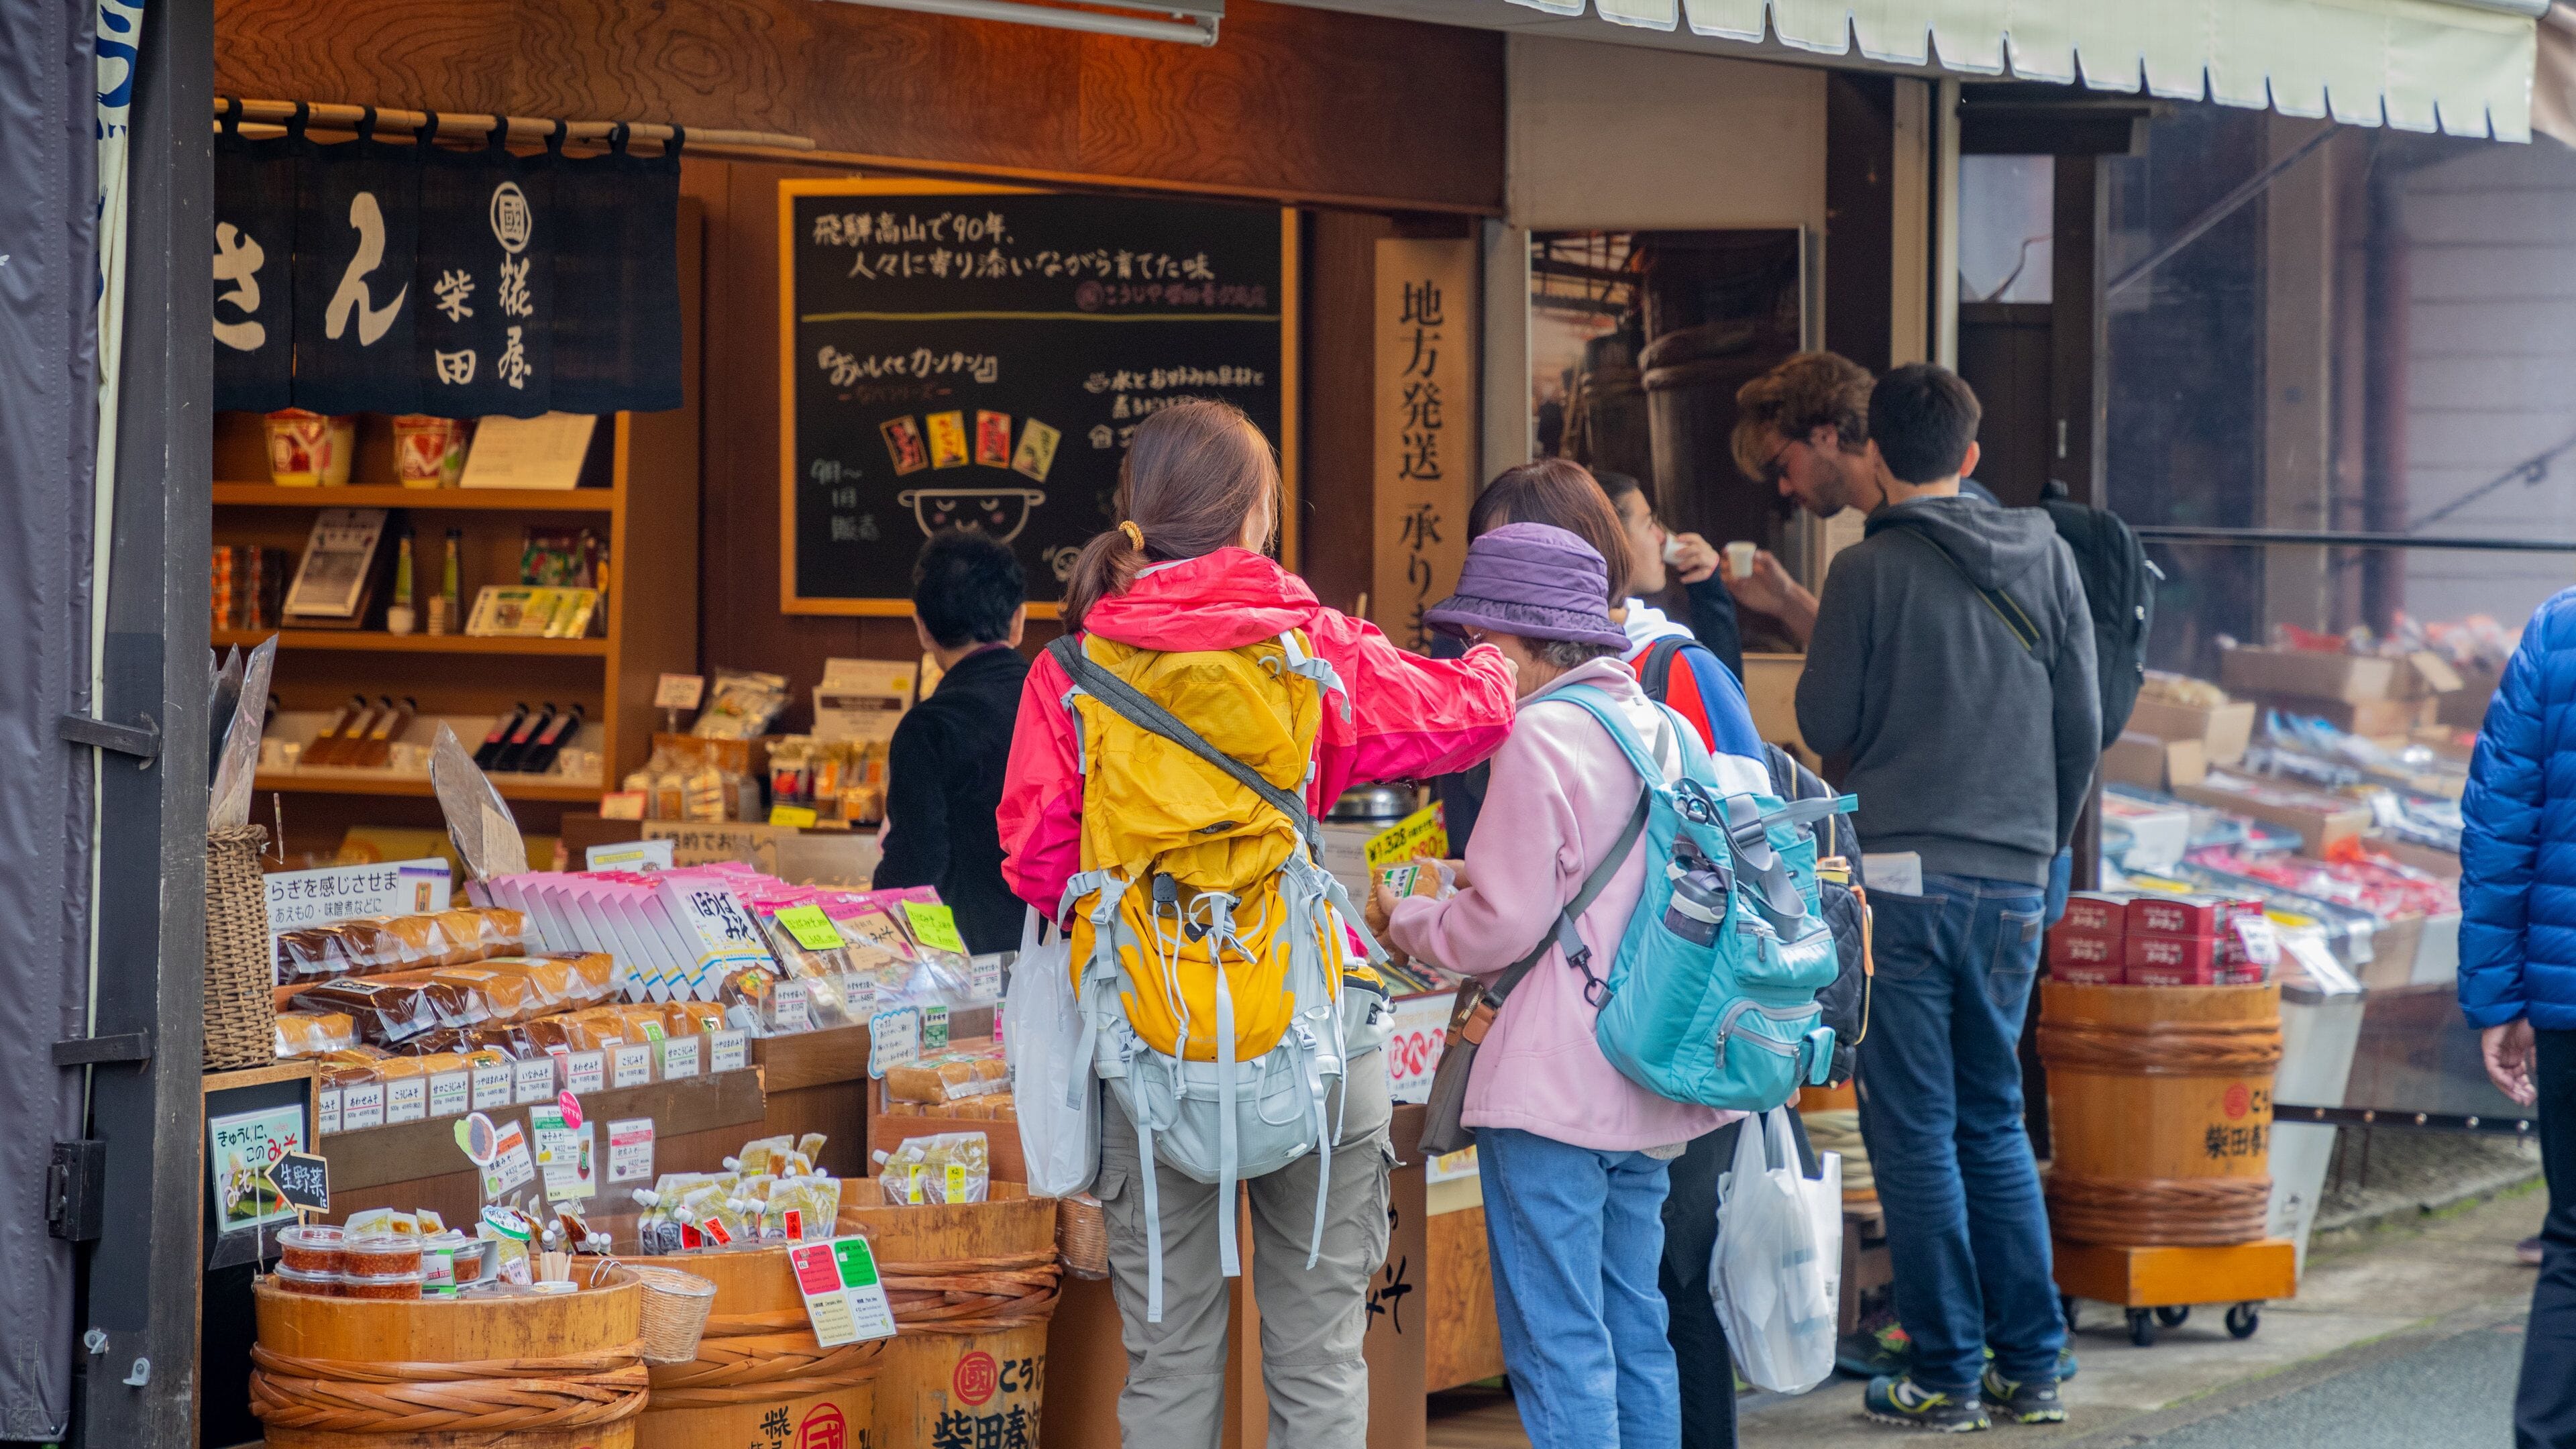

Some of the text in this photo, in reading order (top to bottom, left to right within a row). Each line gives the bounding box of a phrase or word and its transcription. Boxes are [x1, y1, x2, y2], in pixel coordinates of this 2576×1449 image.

[847, 246, 1215, 280] 人々に寄り添いながら育てた味
[433, 270, 476, 386] 柴田
[1398, 279, 1445, 482] 地方発送
[272, 871, 398, 902] らぎを感じさせま
[573, 1061, 598, 1073] あわせみそ
[622, 1053, 644, 1067] こうじみそ
[475, 1073, 509, 1085] つやほまれみそ
[522, 1067, 549, 1080] いなかみそ
[395, 1087, 419, 1099] こうじみそ
[433, 1079, 466, 1094] 甘口こうじみそ
[350, 1093, 378, 1107] あわせみそ
[280, 1163, 325, 1197] 生野菜
